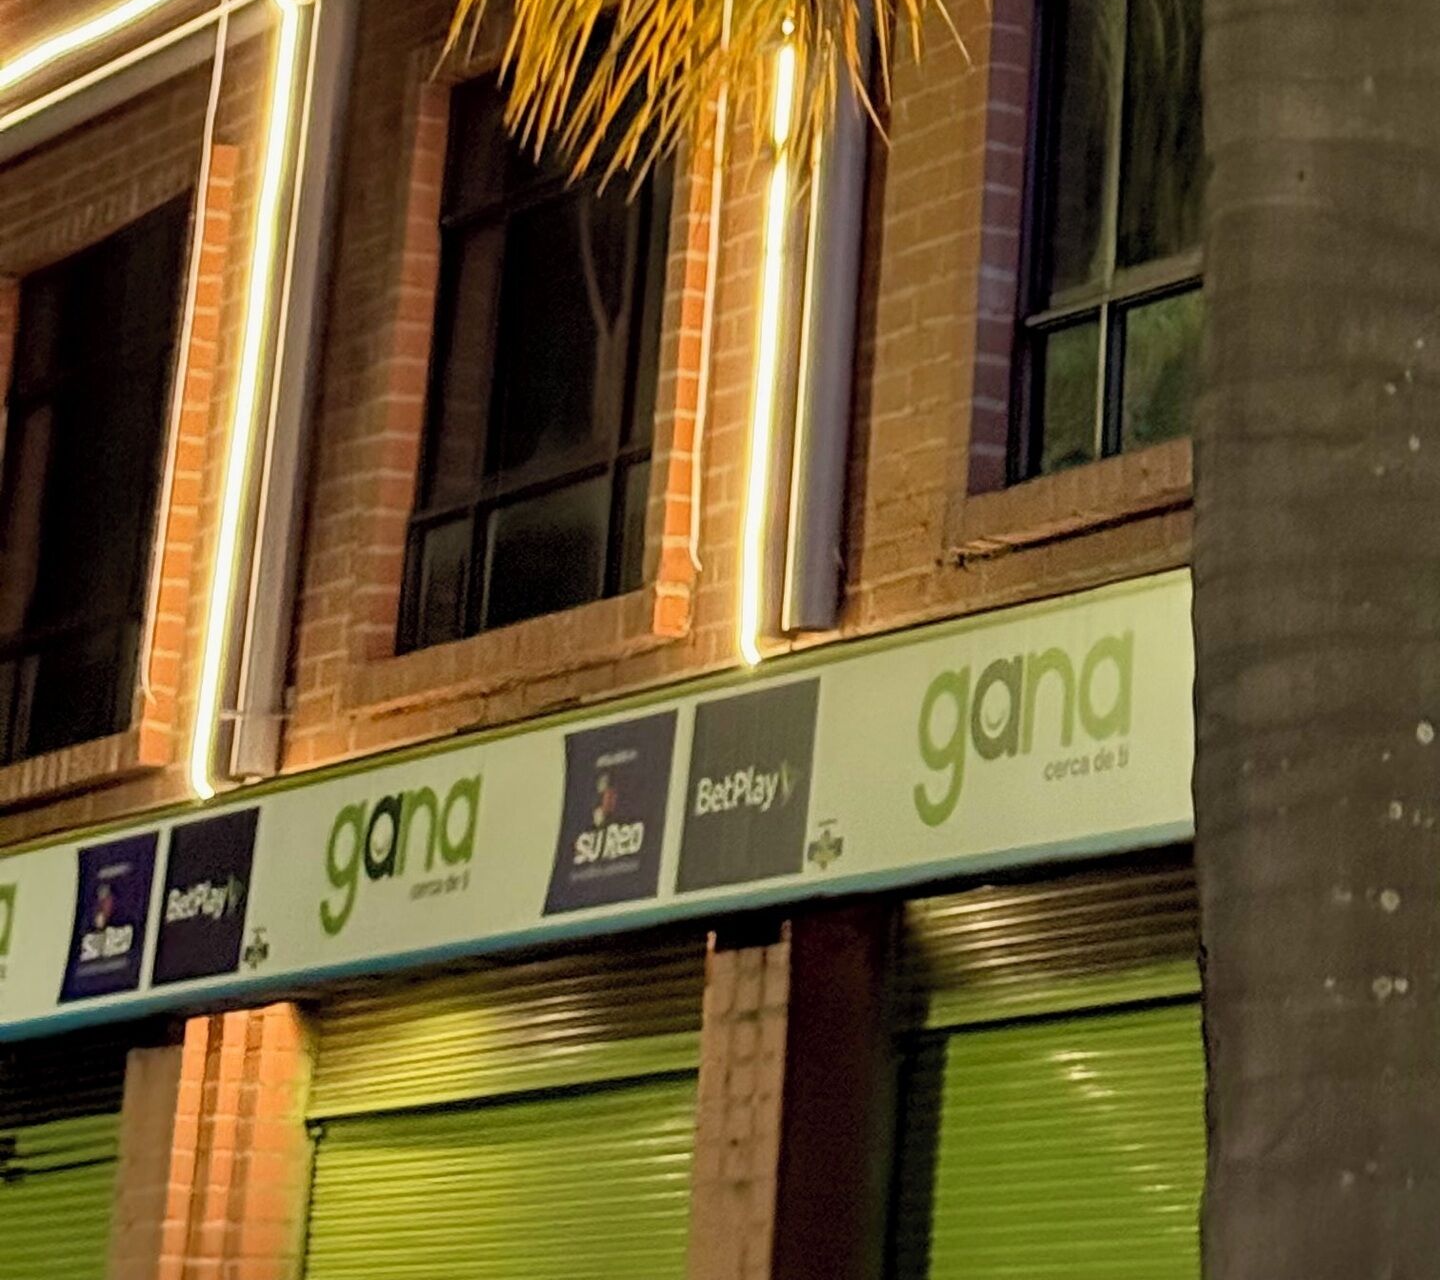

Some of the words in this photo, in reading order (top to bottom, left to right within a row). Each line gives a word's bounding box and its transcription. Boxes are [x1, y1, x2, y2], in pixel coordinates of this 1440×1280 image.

[695, 765, 779, 816] BetPlay
[914, 629, 1134, 827] gana
[320, 773, 482, 936] gana
